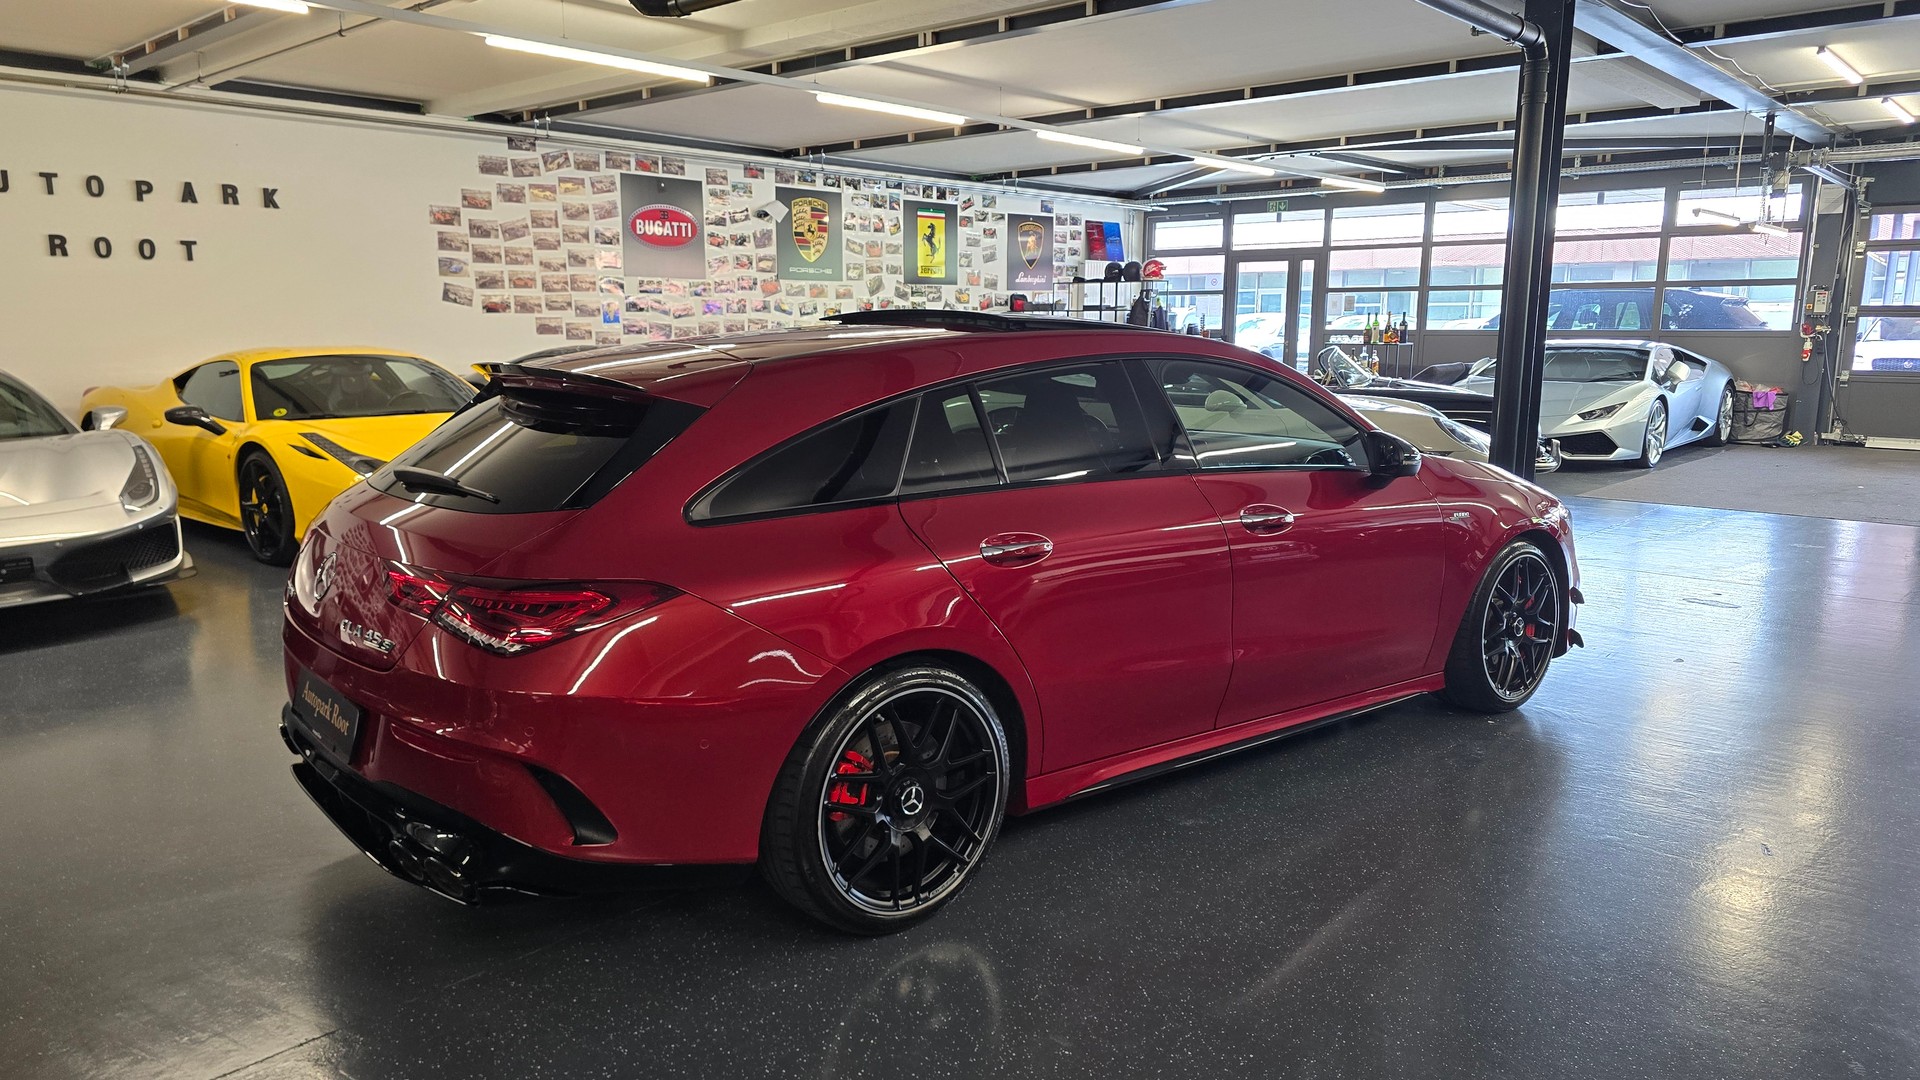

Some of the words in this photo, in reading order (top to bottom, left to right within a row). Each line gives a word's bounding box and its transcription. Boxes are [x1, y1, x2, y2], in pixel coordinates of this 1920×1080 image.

[793, 199, 826, 210] PORSCHE
[636, 219, 692, 237] BUGATTI
[48, 234, 198, 261] ROOT
[789, 267, 833, 275] PORSCHE
[1015, 271, 1047, 285] Lamborghini
[340, 619, 364, 638] CLA
[364, 629, 383, 644] 45
[302, 680, 333, 721] Autopark
[331, 703, 350, 736] Root
